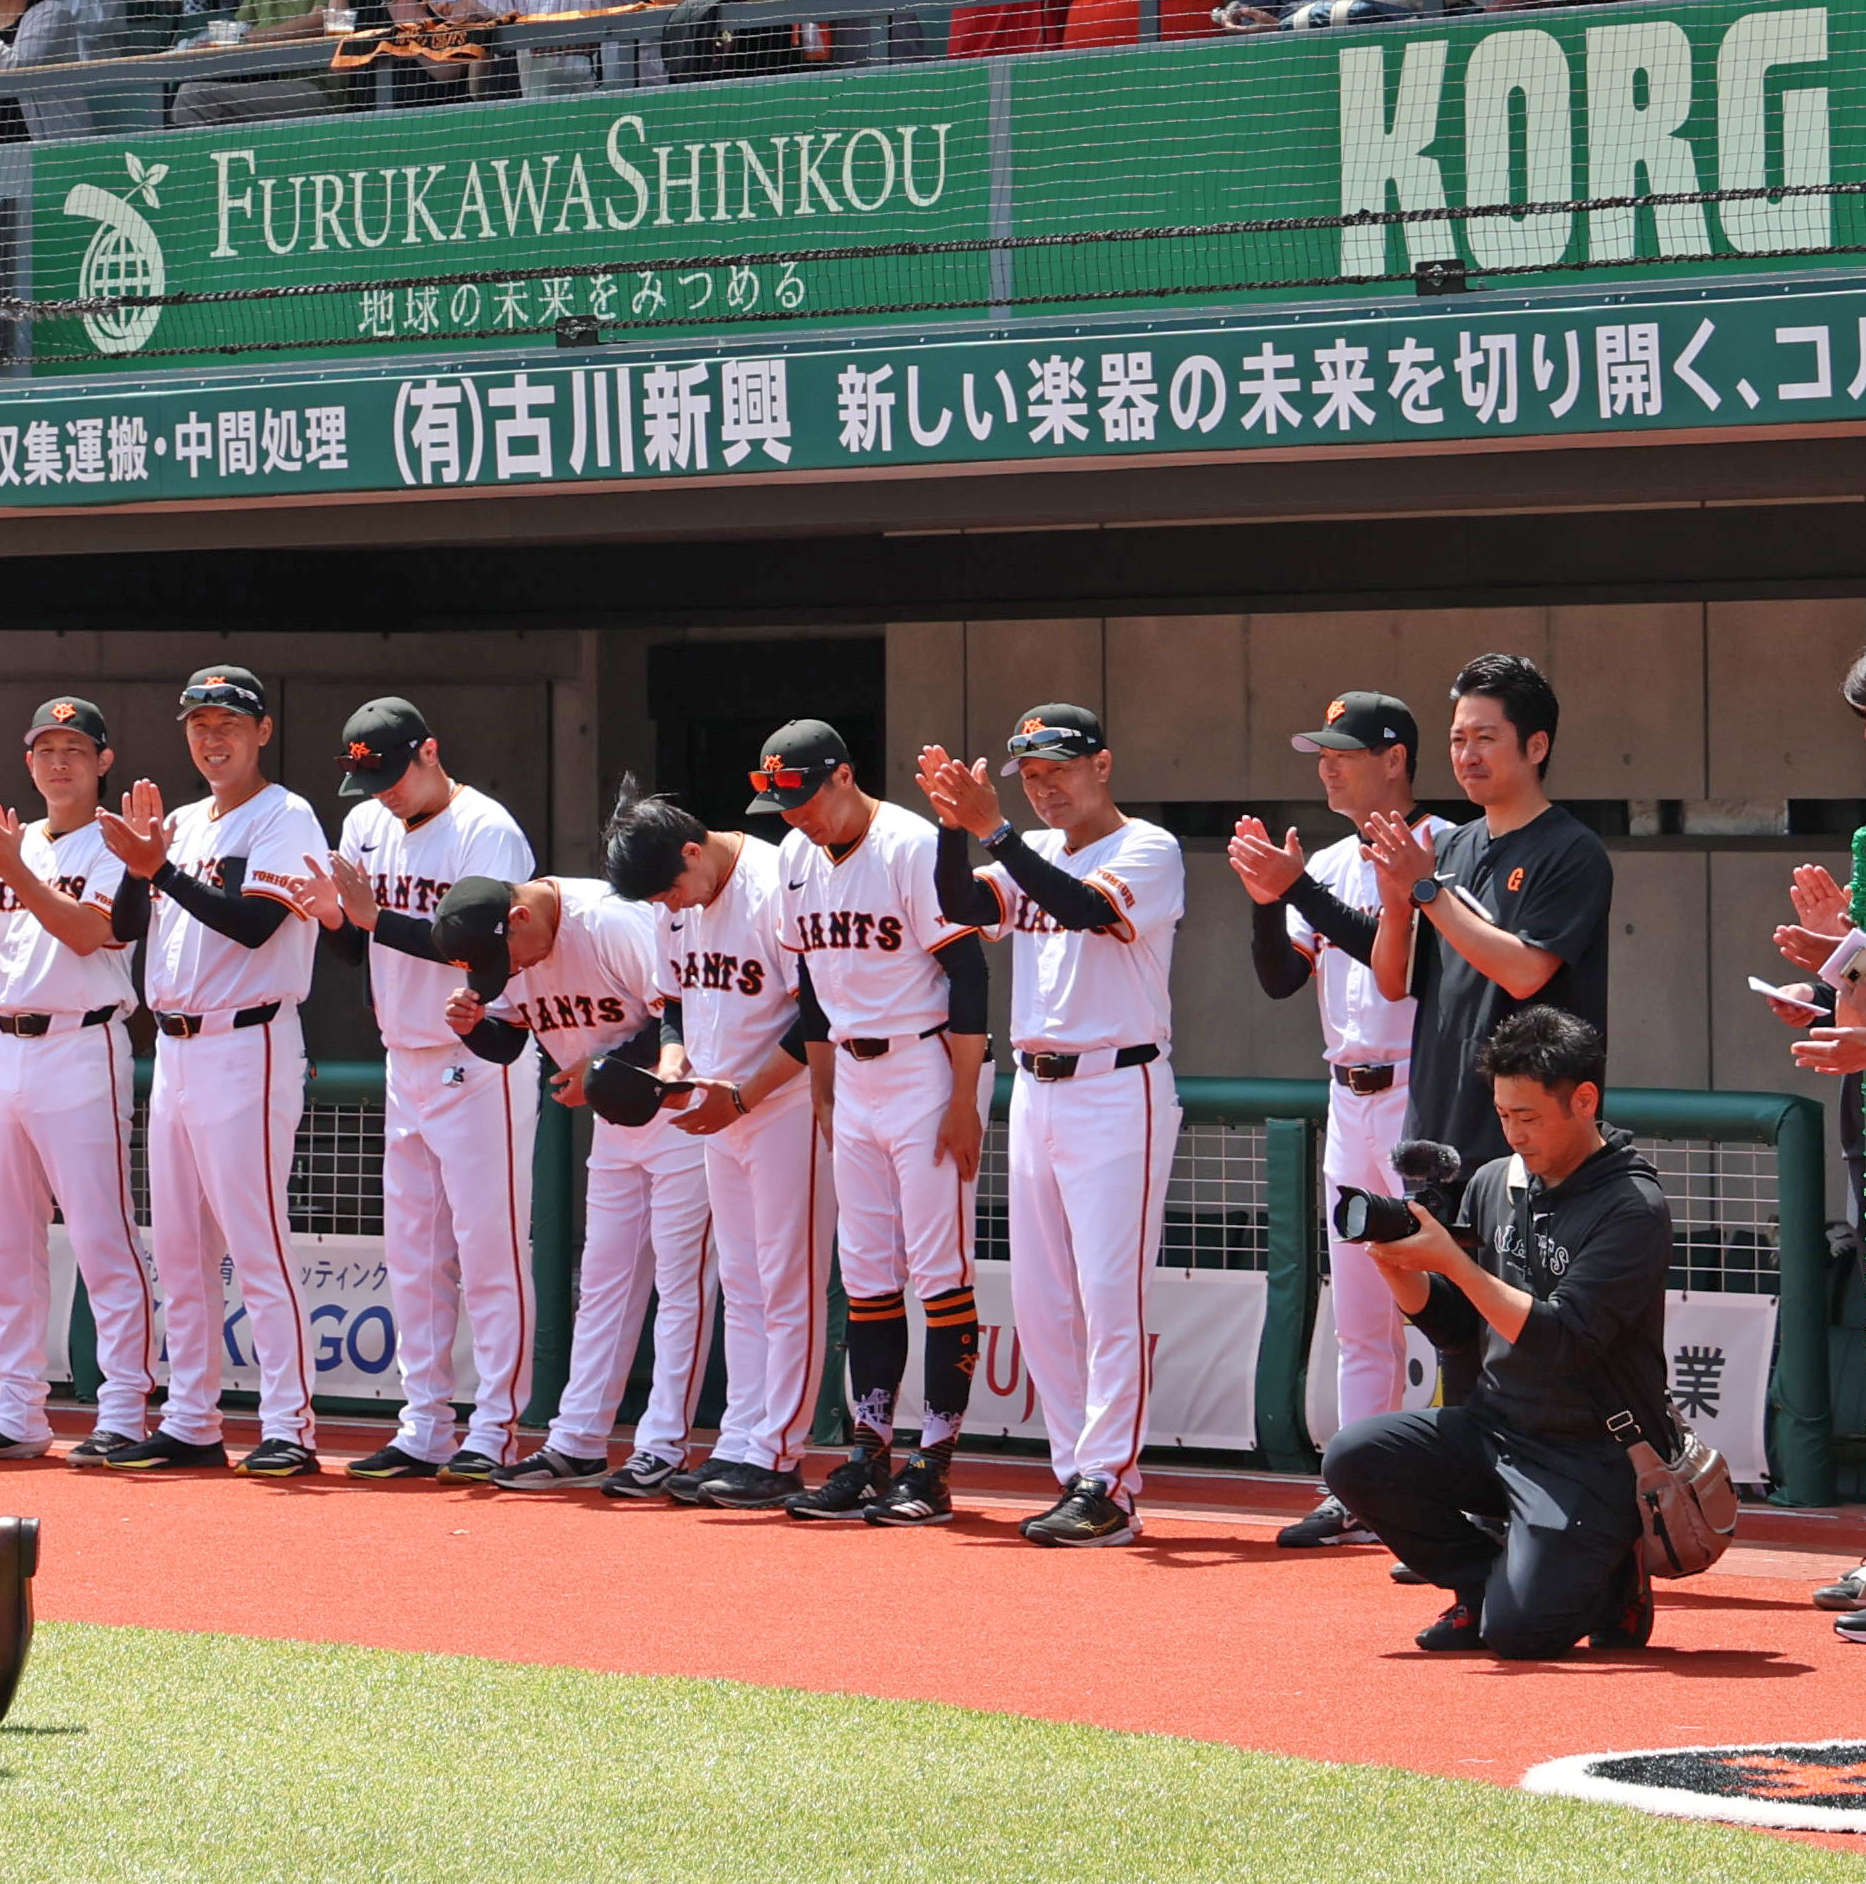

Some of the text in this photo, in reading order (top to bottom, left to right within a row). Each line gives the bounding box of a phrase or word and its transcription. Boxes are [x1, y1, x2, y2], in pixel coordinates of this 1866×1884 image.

[1339, 7, 1832, 276] KORG
[358, 260, 806, 338] 地球の未来をみつめる
[797, 910, 902, 952] IANTS
[518, 994, 626, 1033] IANTS
[1674, 1346, 1726, 1419] 業
